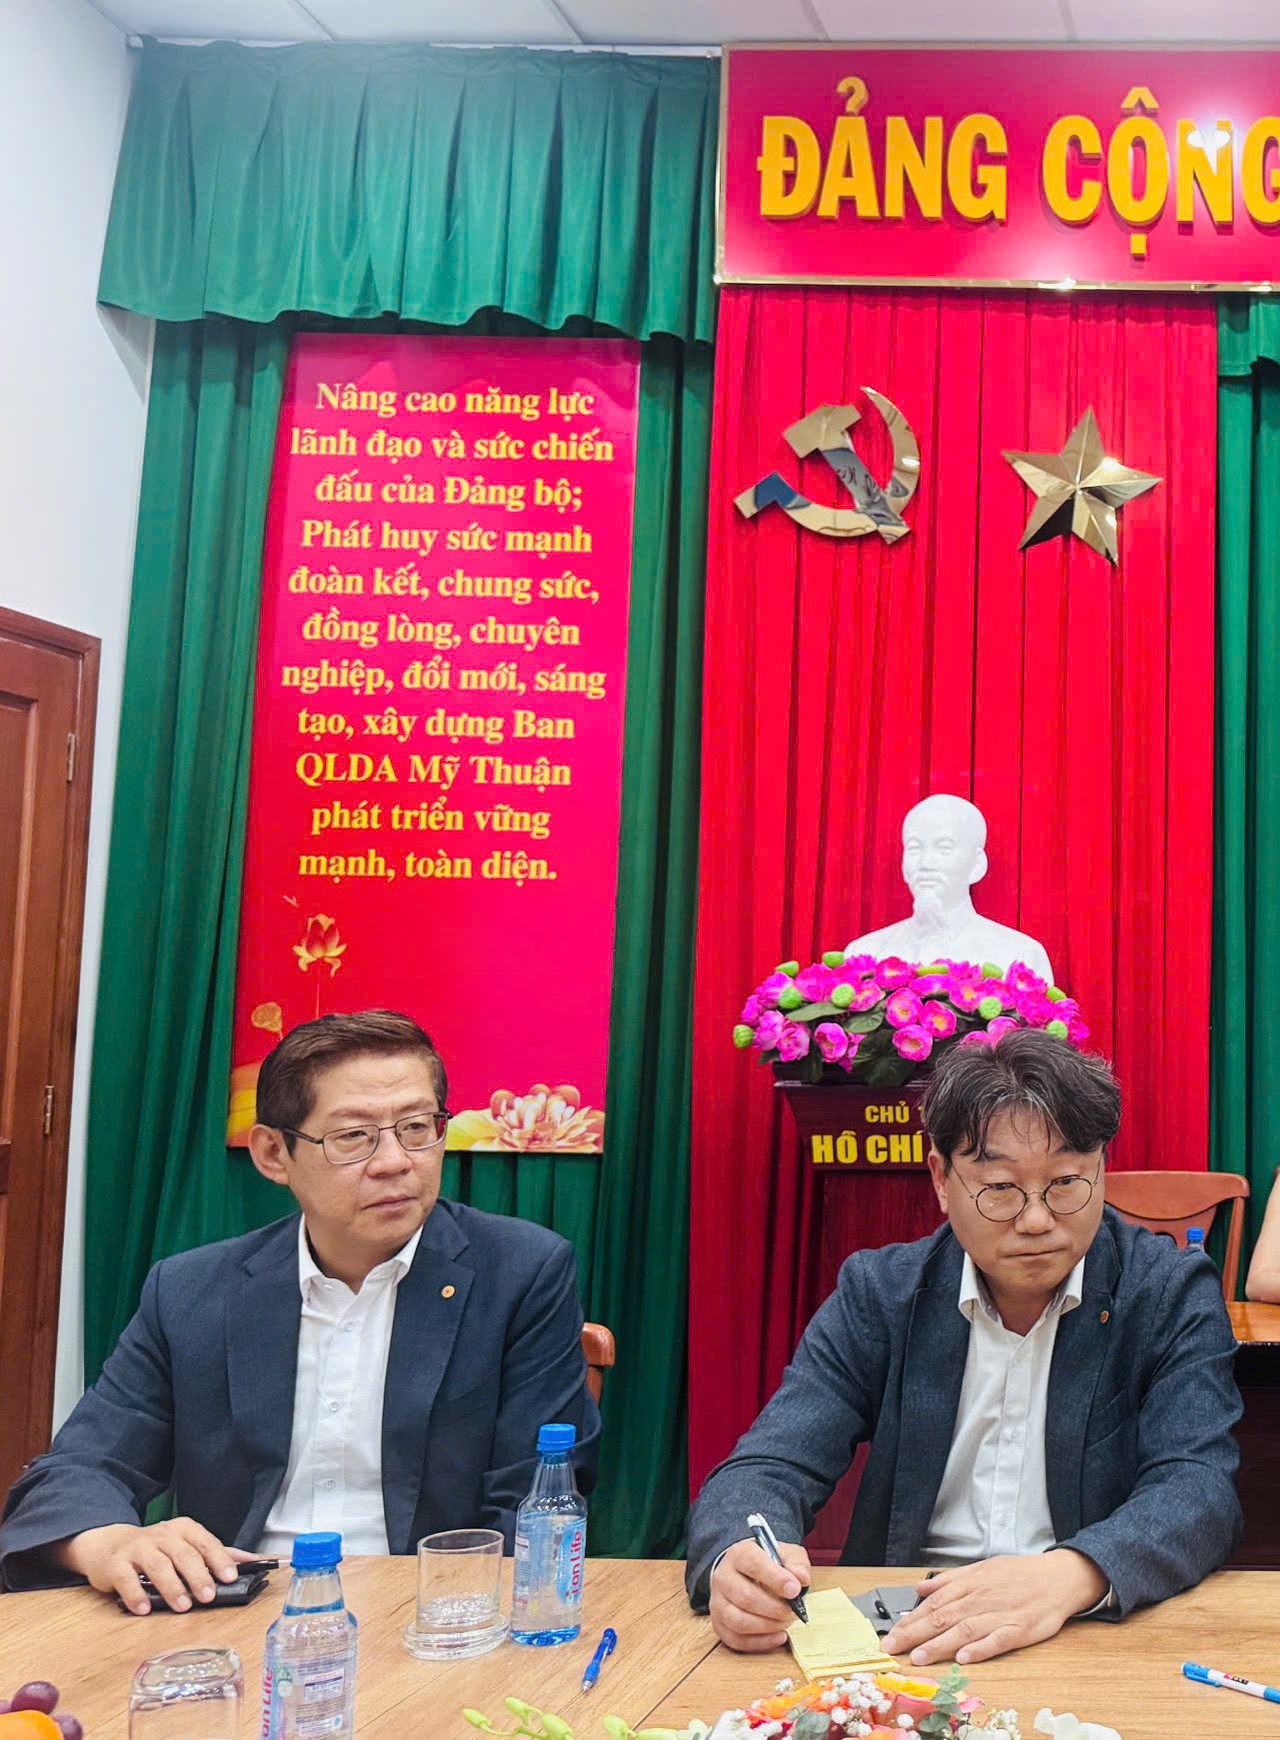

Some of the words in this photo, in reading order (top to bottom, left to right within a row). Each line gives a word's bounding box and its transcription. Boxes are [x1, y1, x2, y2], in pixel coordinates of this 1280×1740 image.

[756, 76, 1007, 222] ĐẢNG
[315, 382, 398, 419] Nâng
[404, 392, 457, 413] cao
[464, 386, 541, 421] năng
[548, 387, 595, 422] lực
[290, 427, 358, 457] lãnh
[365, 429, 423, 465] đạo
[431, 429, 466, 459] và
[473, 431, 525, 460] sức
[532, 427, 614, 461] chiến
[315, 468, 373, 503] đấu
[380, 473, 435, 504] của
[443, 475, 526, 513] Đảng
[534, 477, 582, 514] bộ;
[300, 519, 373, 549] Phát
[380, 521, 439, 557] huy
[445, 521, 498, 552] sức
[505, 524, 592, 560] mạnh
[288, 565, 364, 595] đoàn
[372, 561, 430, 601] kết,
[437, 568, 533, 605] chung
[539, 570, 600, 605] sức,
[302, 606, 379, 649] đồng
[387, 613, 462, 650] lòng,
[469, 615, 580, 652] chuyên
[281, 658, 394, 696] nghiệp,
[402, 654, 451, 690] đổi
[458, 661, 527, 696] mới,
[534, 663, 607, 700] sáng
[298, 708, 354, 741] tạo,
[363, 706, 418, 743] xây
[425, 708, 505, 745] dựng
[512, 709, 575, 739] Ban
[296, 752, 398, 787] QLDA
[408, 754, 460, 791] Mỹ
[469, 755, 571, 793] Thuận
[311, 800, 382, 836] phát
[391, 795, 464, 831] triển
[474, 803, 551, 840] vững
[299, 848, 396, 884] mạnh,
[405, 848, 472, 878] toàn
[481, 850, 557, 887] diện.
[865, 1100, 910, 1123] CHỦ
[866, 1129, 924, 1164] CHÍ
